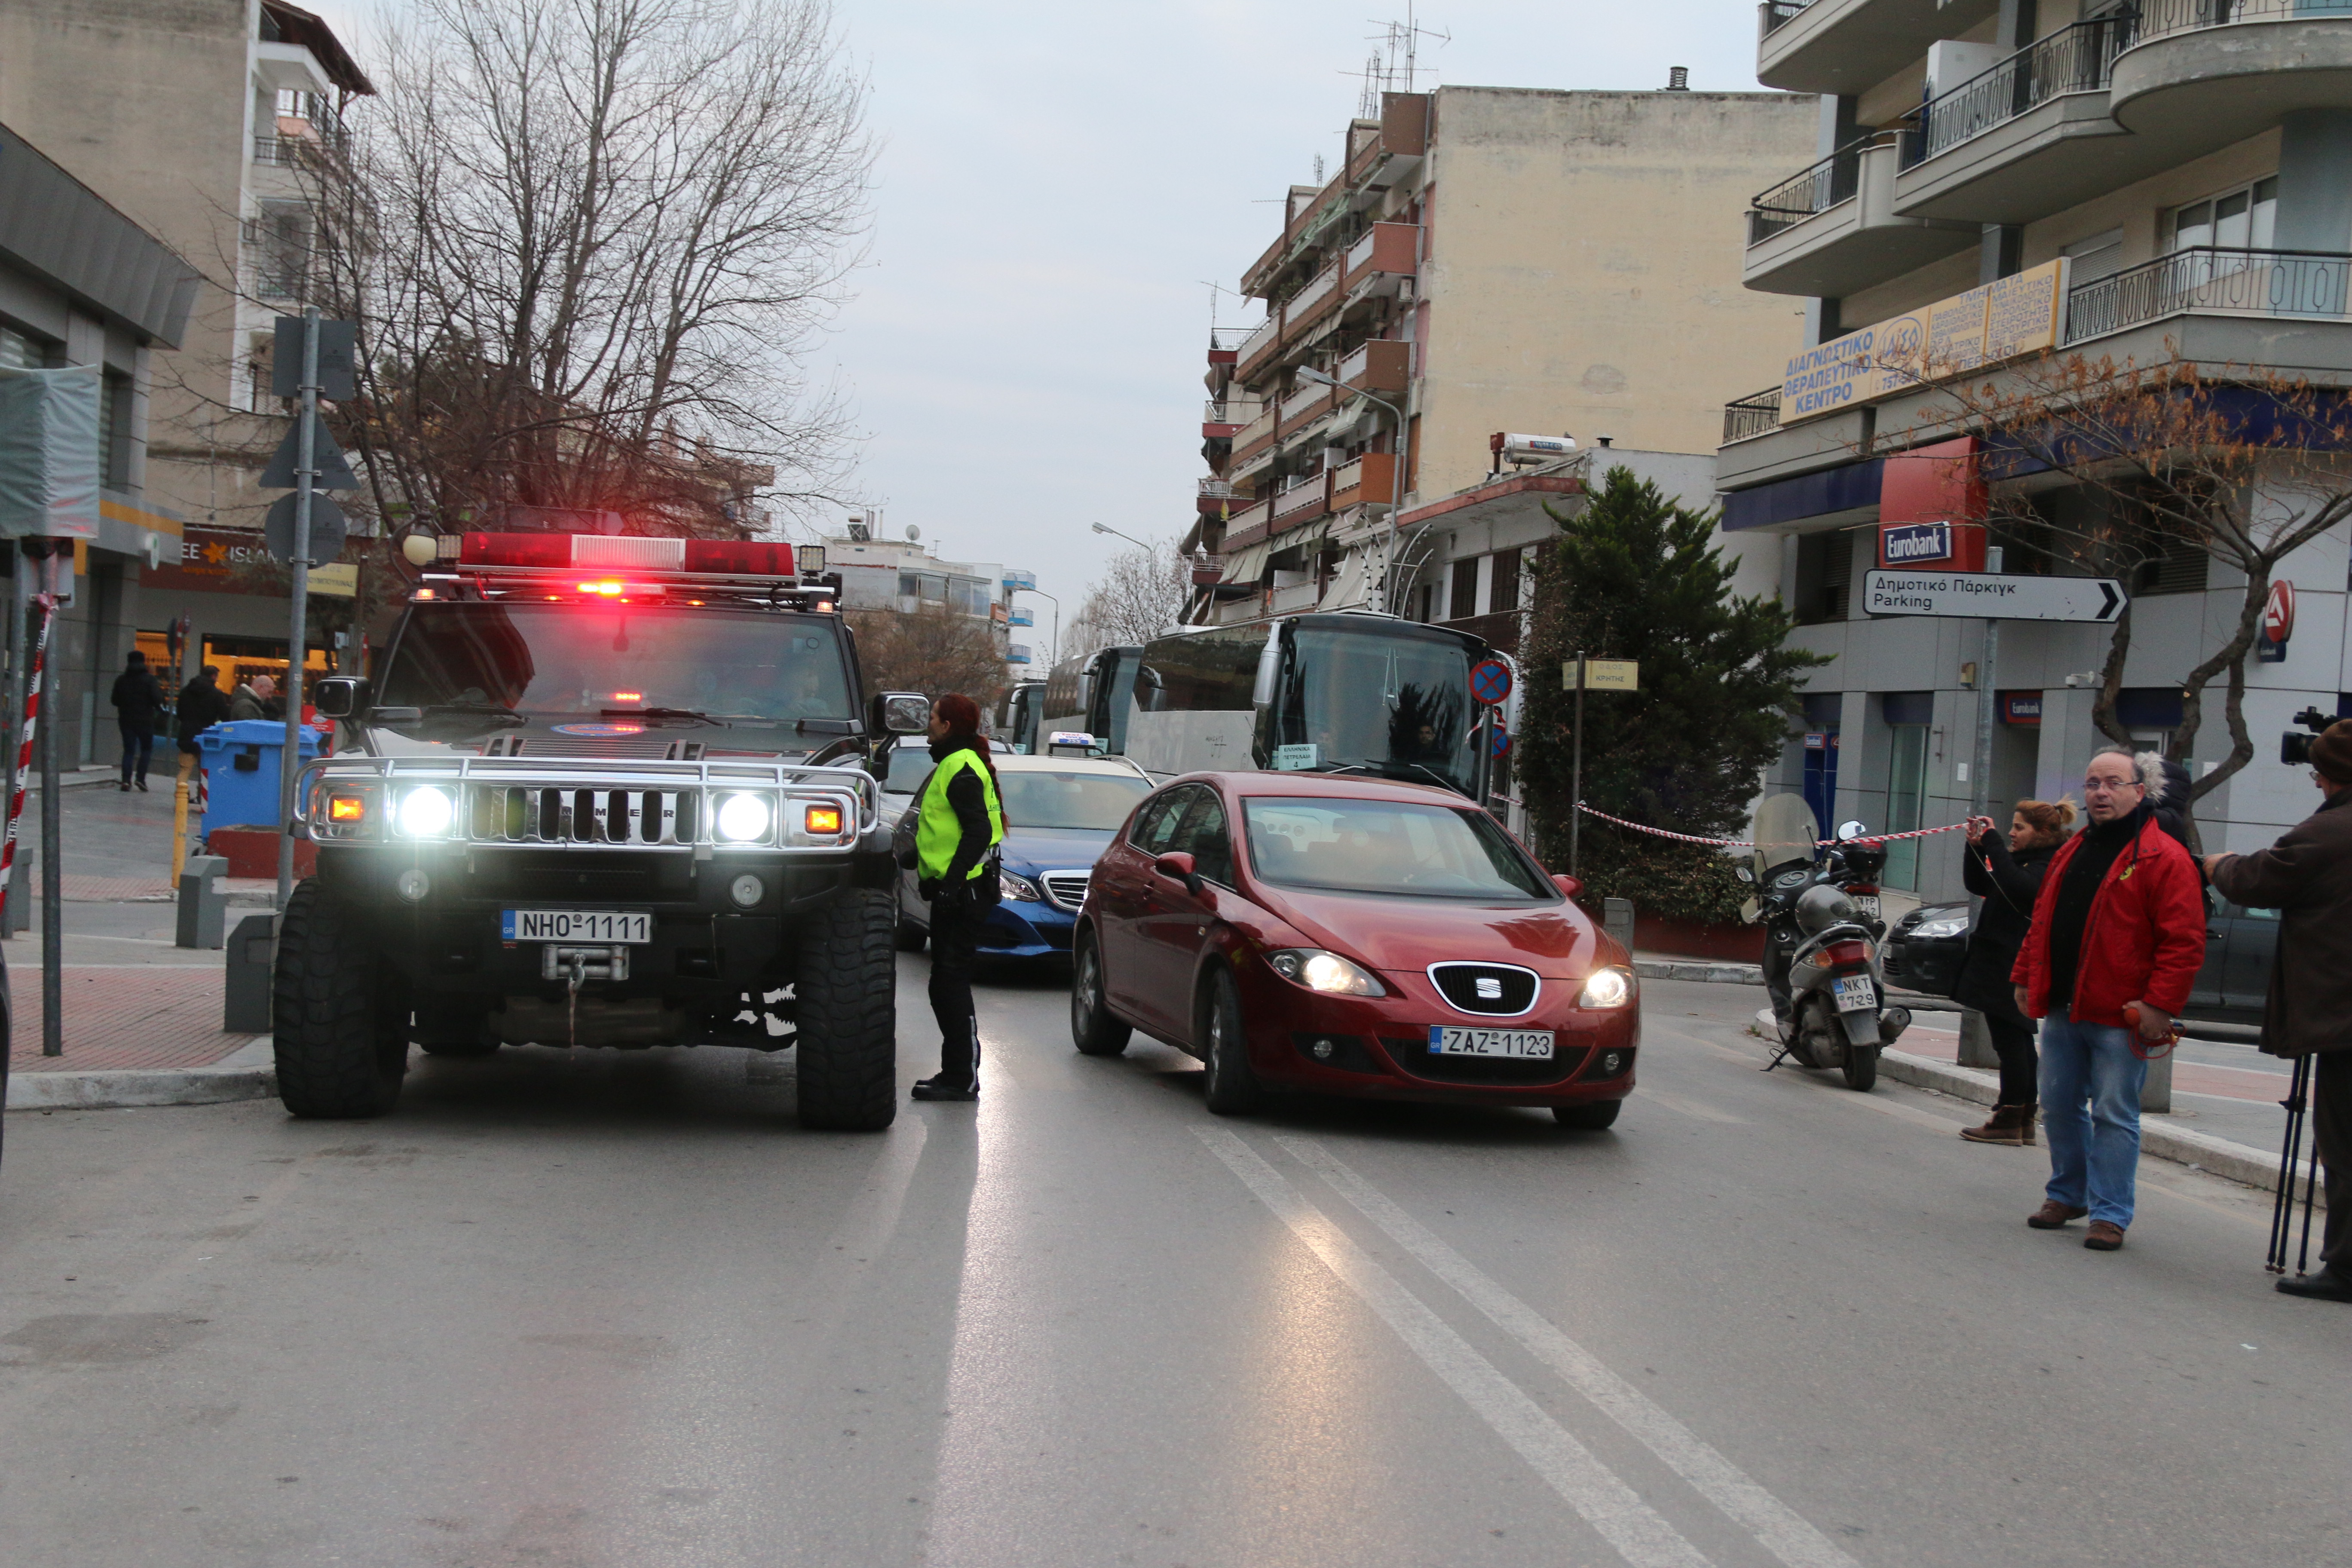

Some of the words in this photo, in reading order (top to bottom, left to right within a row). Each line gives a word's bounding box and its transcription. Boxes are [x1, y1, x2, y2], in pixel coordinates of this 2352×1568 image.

[1992, 275, 2053, 302] ΜΑΙΕΥΤΙΚΟ
[1989, 305, 2049, 331] ΣΤΕΙΡΟΤΗΤΑ
[1785, 331, 1873, 377] ΔΙΑΓΝΩΣΤΙΚΟ
[1785, 354, 1871, 398] ΘΕΡΑΠΕΥΤΙΚΟ
[1795, 382, 1853, 414] ΚΕΝΤΡΟ
[1887, 527, 1941, 558] Eurobank
[1875, 576, 1947, 594] Δημοτικό
[1953, 579, 2016, 597] Πάρκιγκ
[1874, 593, 1932, 611] Parking
[523, 913, 645, 940] NHO-1111
[1842, 978, 1869, 992] NKT
[1847, 993, 1874, 1008] 729
[1448, 1030, 1550, 1056] ZAZ-1123
